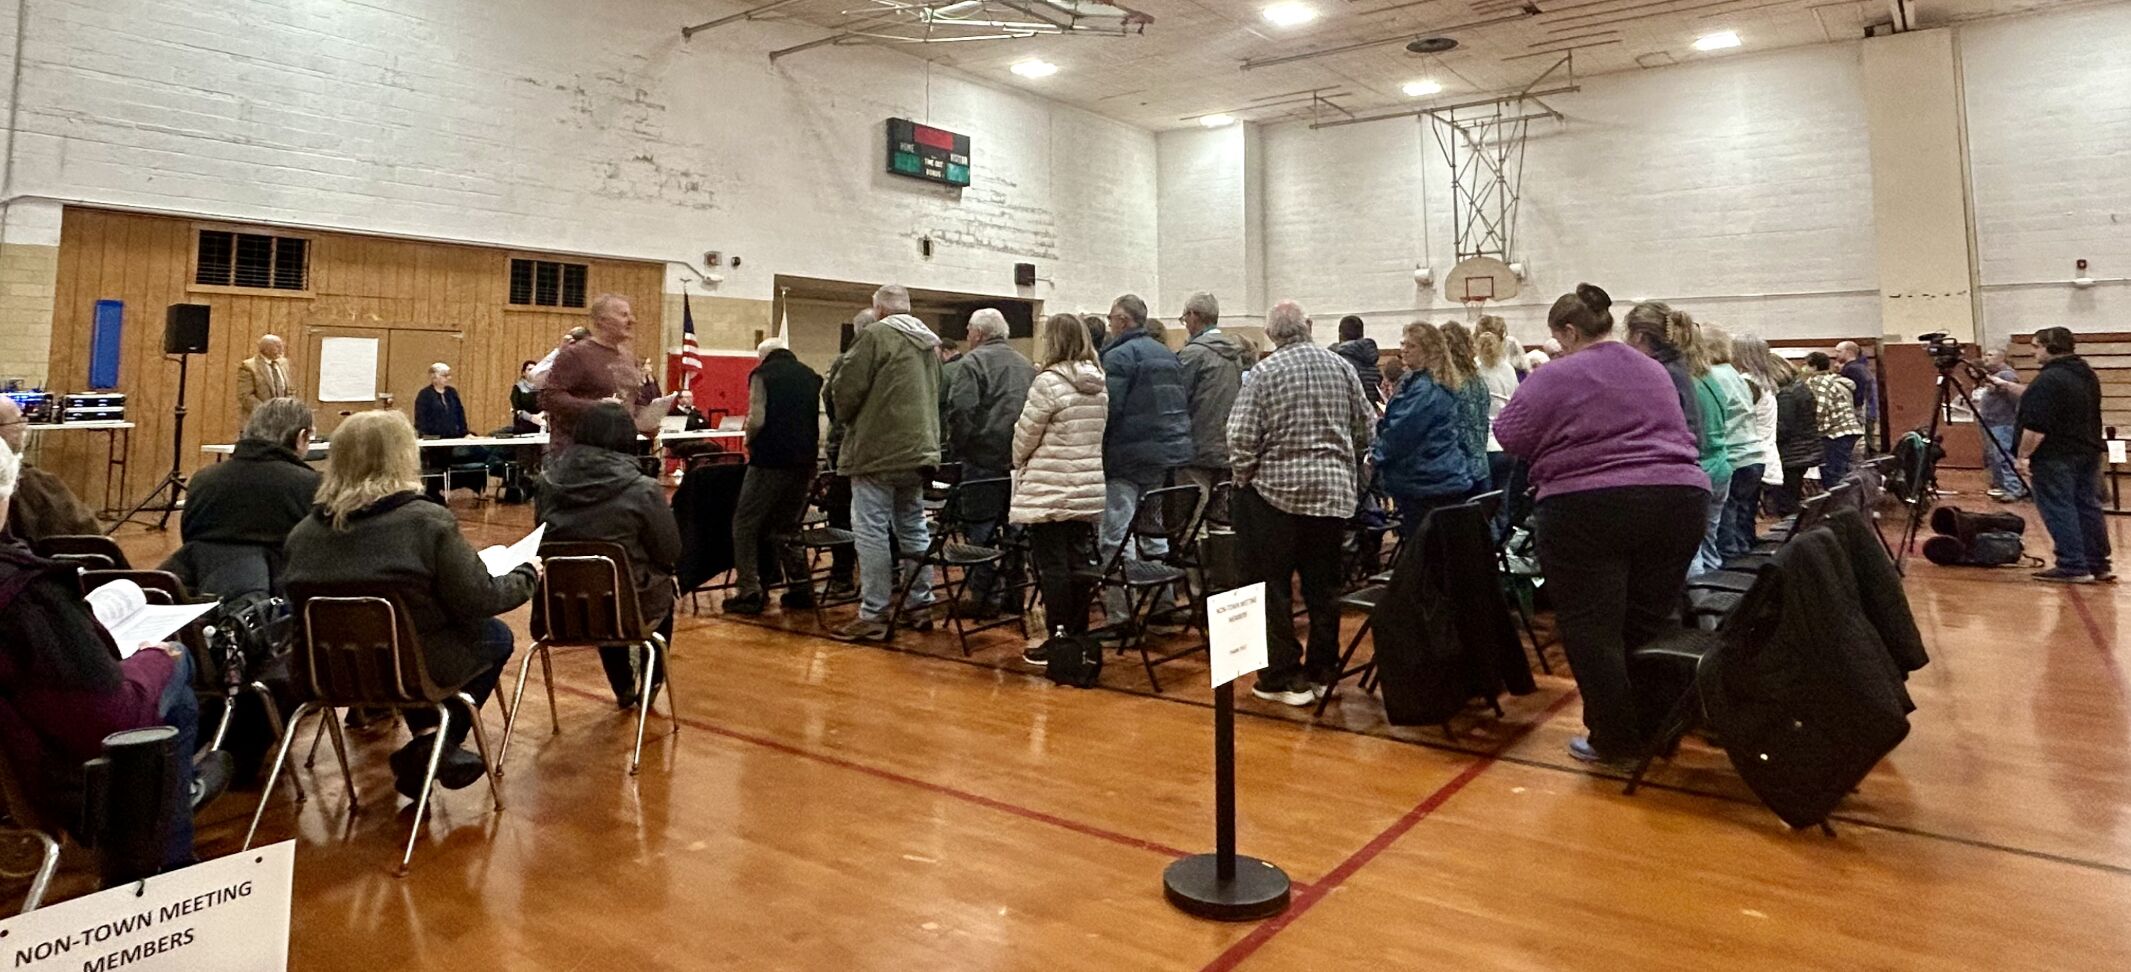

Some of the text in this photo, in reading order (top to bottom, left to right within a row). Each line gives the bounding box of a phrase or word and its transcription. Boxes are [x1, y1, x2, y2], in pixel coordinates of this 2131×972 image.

[14, 881, 252, 968] NON-TOWN MEETING
[83, 928, 195, 972] MEMBERS
